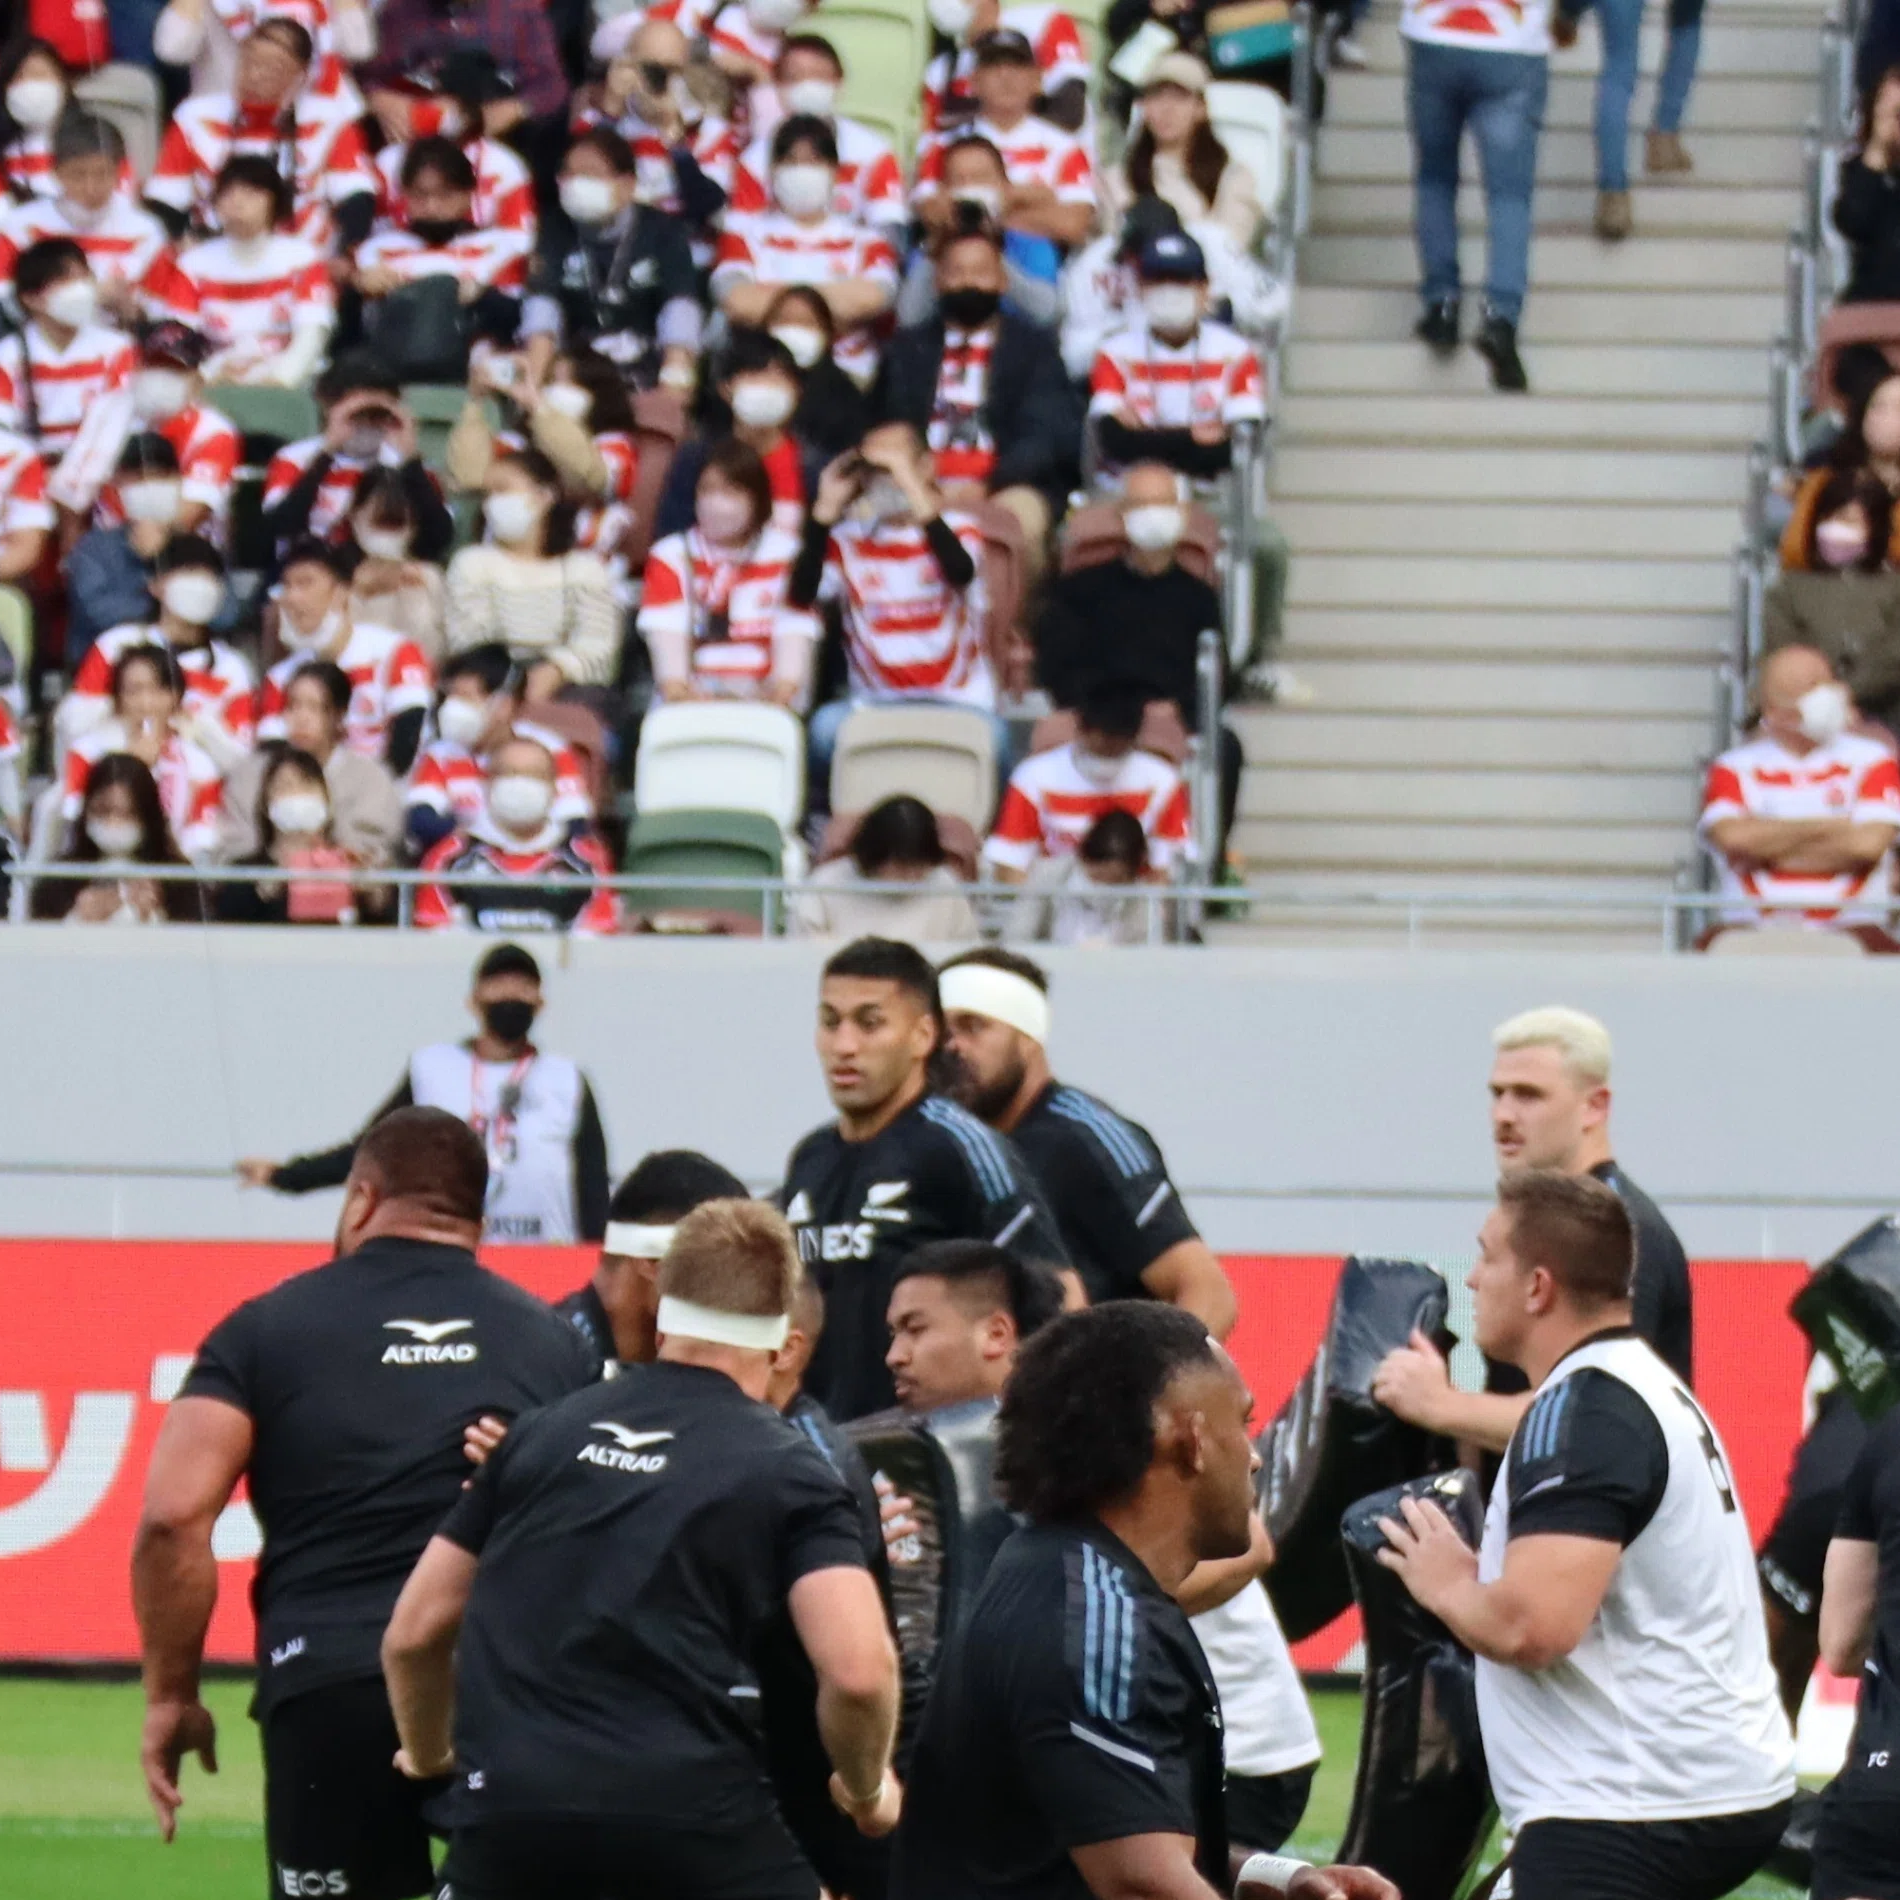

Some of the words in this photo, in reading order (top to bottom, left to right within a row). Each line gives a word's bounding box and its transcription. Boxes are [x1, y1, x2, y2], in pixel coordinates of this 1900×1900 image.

[797, 1223, 877, 1262] INEOS
[381, 1343, 477, 1364] ALTRAD
[576, 1443, 667, 1472] ALTRAD
[1867, 1750, 1890, 1768] FC
[277, 1862, 350, 1897] EOS
